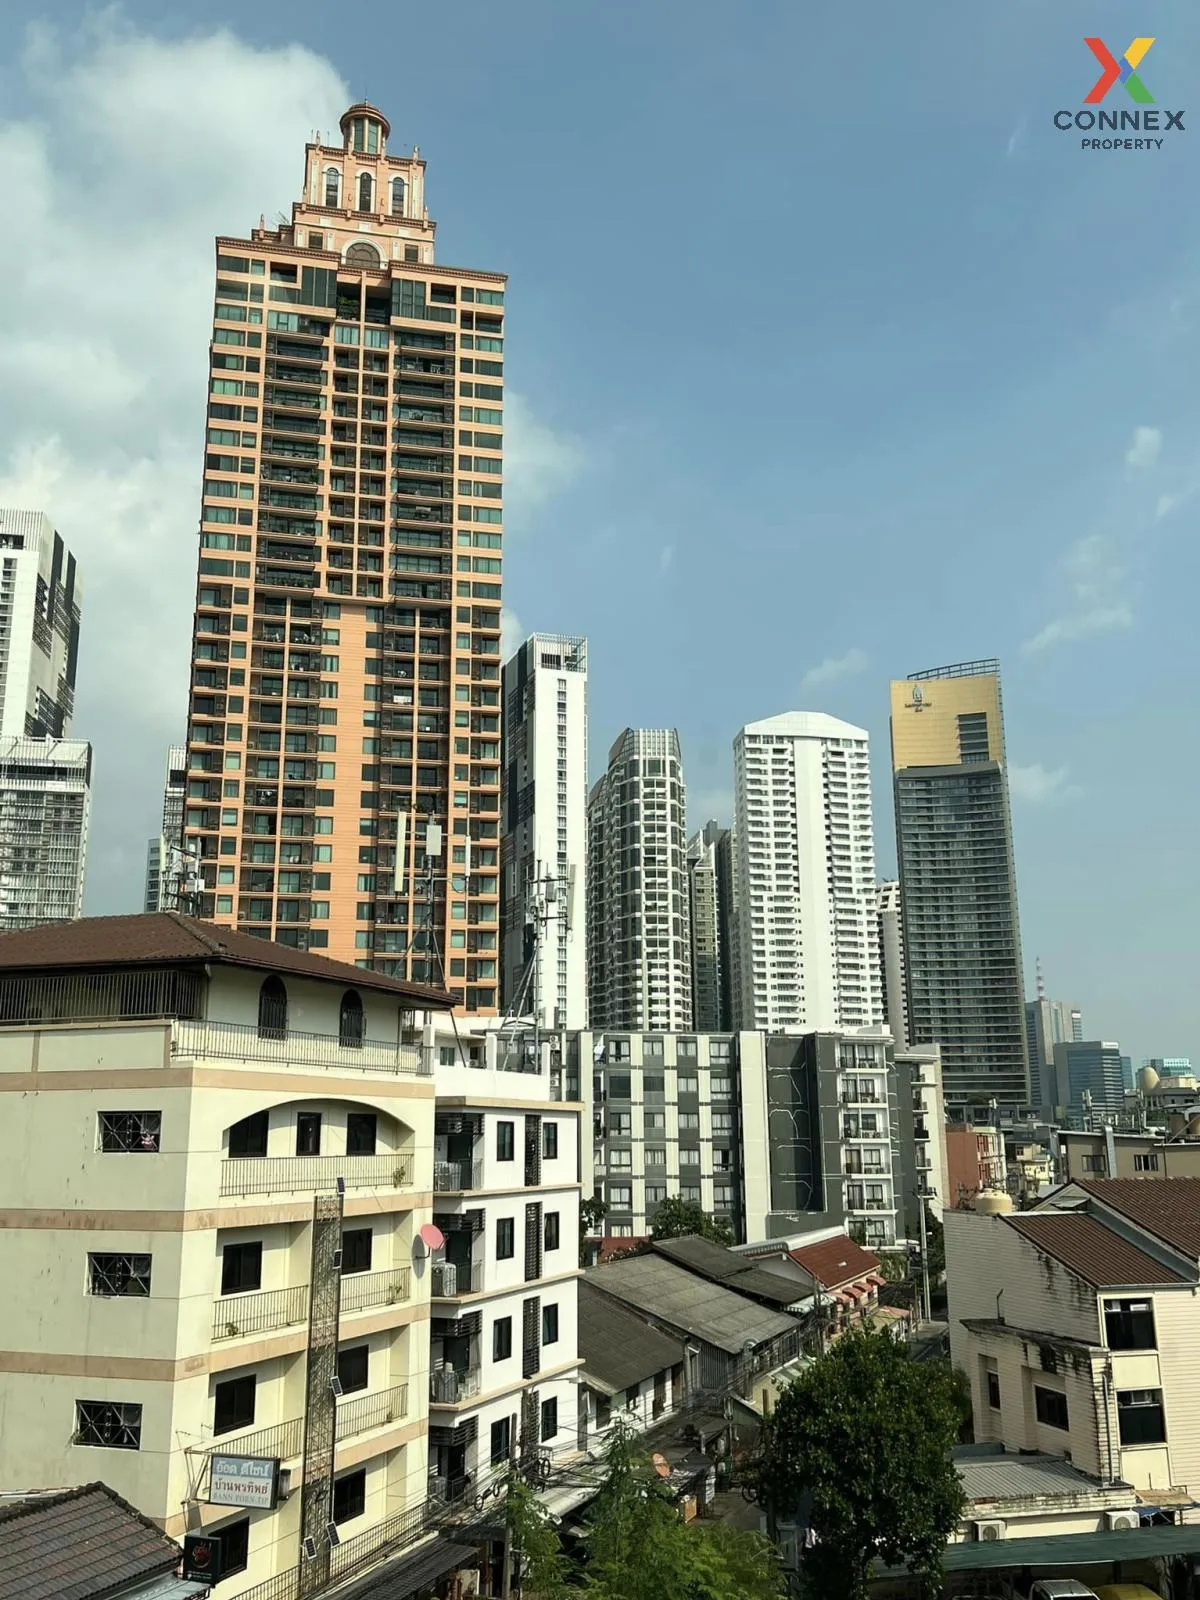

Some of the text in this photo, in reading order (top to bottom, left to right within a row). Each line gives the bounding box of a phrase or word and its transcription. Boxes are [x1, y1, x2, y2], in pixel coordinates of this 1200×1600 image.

[215, 1478, 270, 1494] บ้านพรทิพย์
